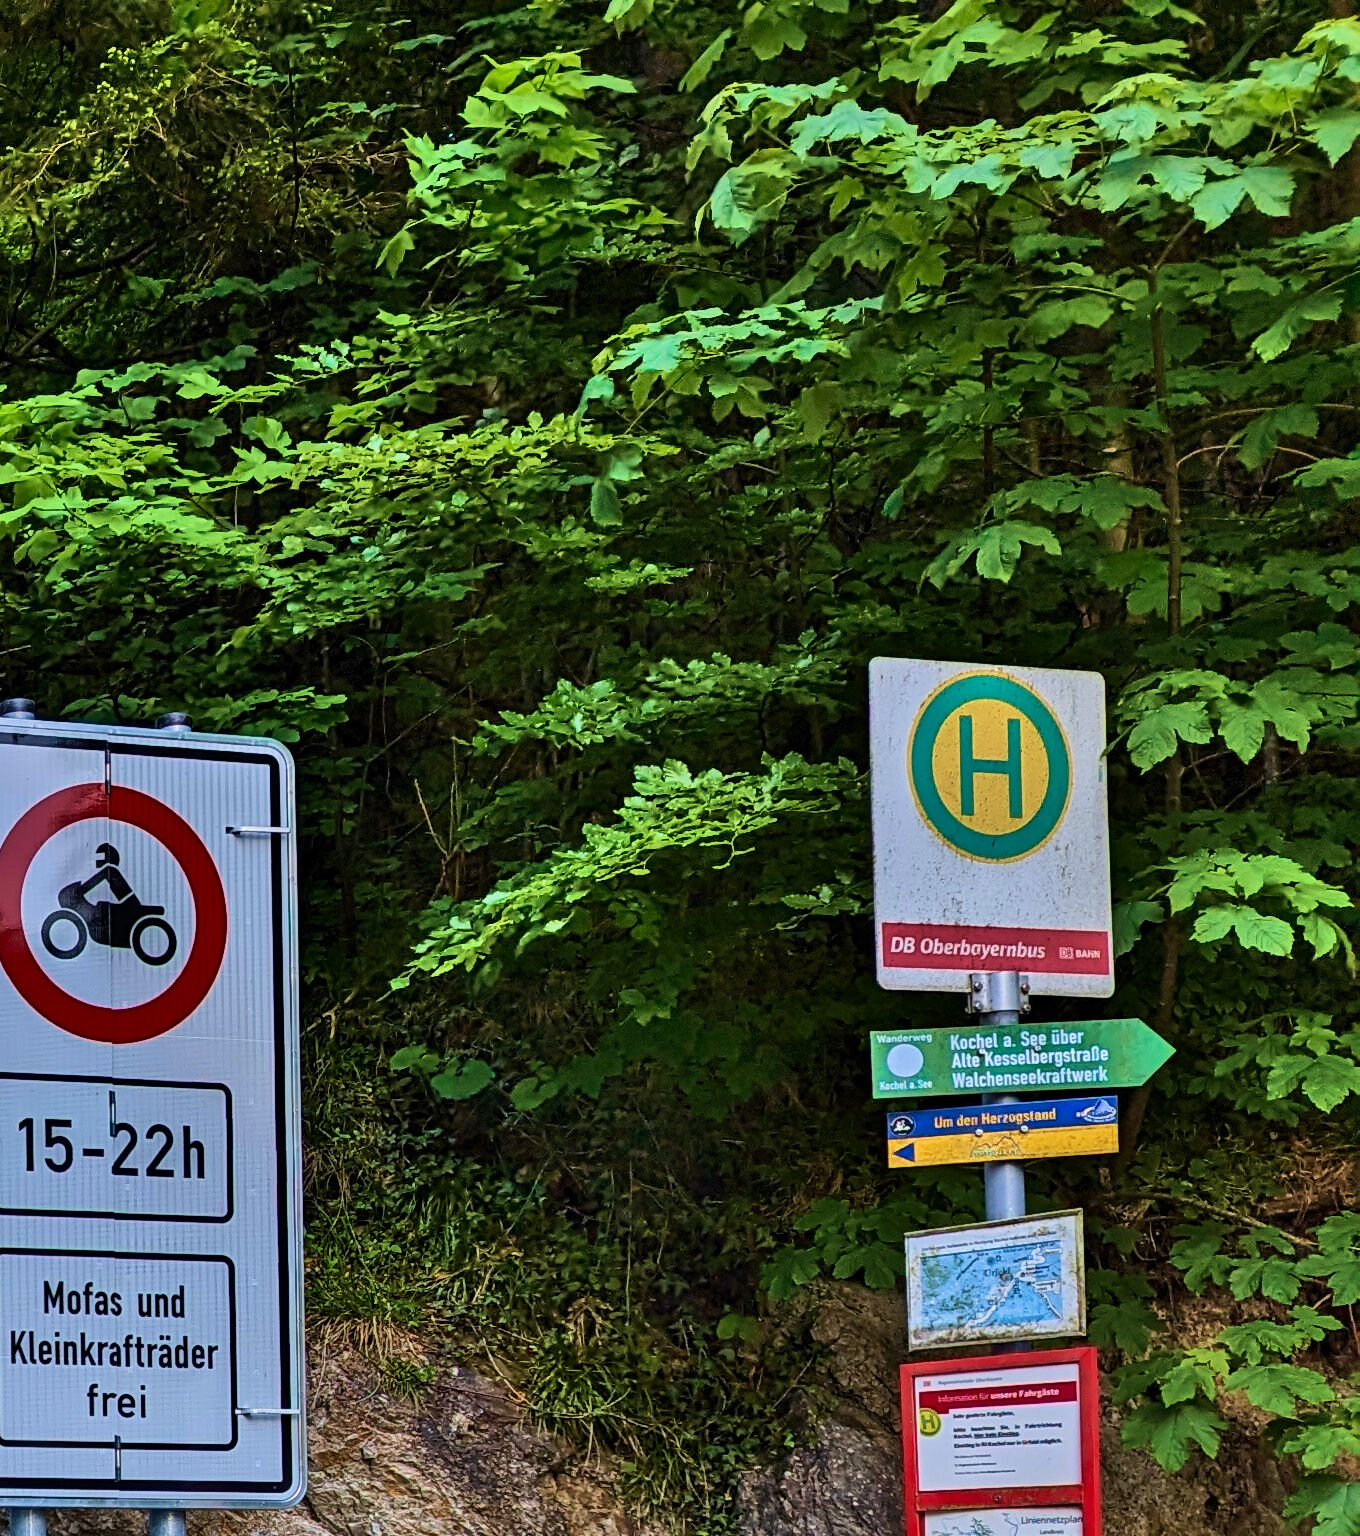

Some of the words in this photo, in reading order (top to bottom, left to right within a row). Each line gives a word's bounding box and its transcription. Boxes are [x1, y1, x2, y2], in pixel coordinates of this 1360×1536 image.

[958, 714, 1023, 819] H
[890, 936, 916, 954] DB
[920, 937, 1046, 960] Oberbayernbus
[1075, 948, 1101, 959] BAHN
[876, 1034, 933, 1043] Wanderweg
[950, 1033, 998, 1051] Kochel
[1003, 1035, 1016, 1048] a.
[1020, 1031, 1047, 1046] See
[1051, 1029, 1084, 1045] über
[951, 1053, 980, 1069] Alte
[984, 1046, 1109, 1067] Kesselbergstraße
[879, 1080, 907, 1090] Kochel
[952, 1066, 1108, 1089] Walchenseekraftwerk
[934, 1115, 954, 1129] Um
[956, 1114, 978, 1127] den
[980, 1108, 1057, 1126] Herzogstand
[17, 1117, 206, 1180] 15-22h
[42, 1280, 123, 1318] Mofas
[136, 1283, 186, 1319] und
[9, 1330, 219, 1371] Kleinkrafträder
[86, 1382, 148, 1419] frei
[990, 1391, 1018, 1400] unsere
[1018, 1388, 1060, 1399] Fahrgäste
